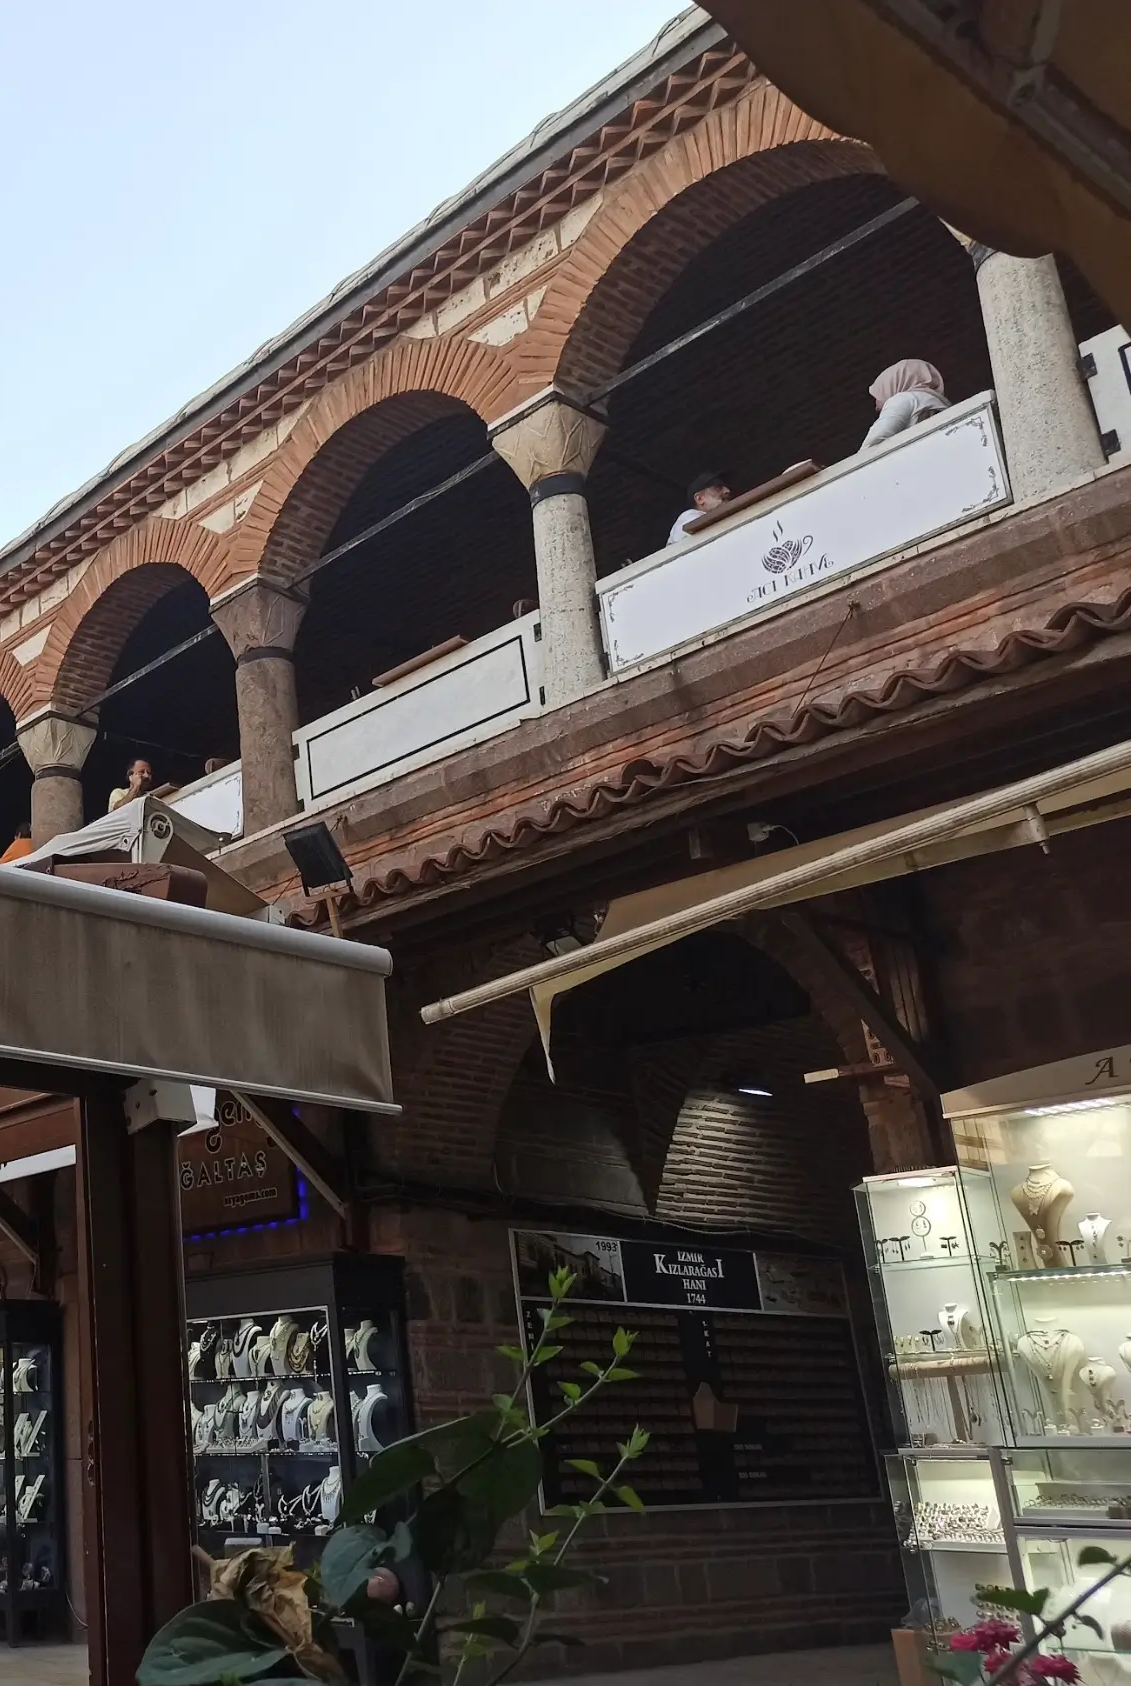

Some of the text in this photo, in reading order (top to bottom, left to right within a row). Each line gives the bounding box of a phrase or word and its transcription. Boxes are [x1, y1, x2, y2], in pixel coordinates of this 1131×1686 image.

[783, 553, 834, 587] KAHVE
[180, 1150, 267, 1191] ĞALTAŞ
[596, 1241, 617, 1253] 1993
[681, 1279, 707, 1291] HANI
[686, 1293, 706, 1304] 1744
